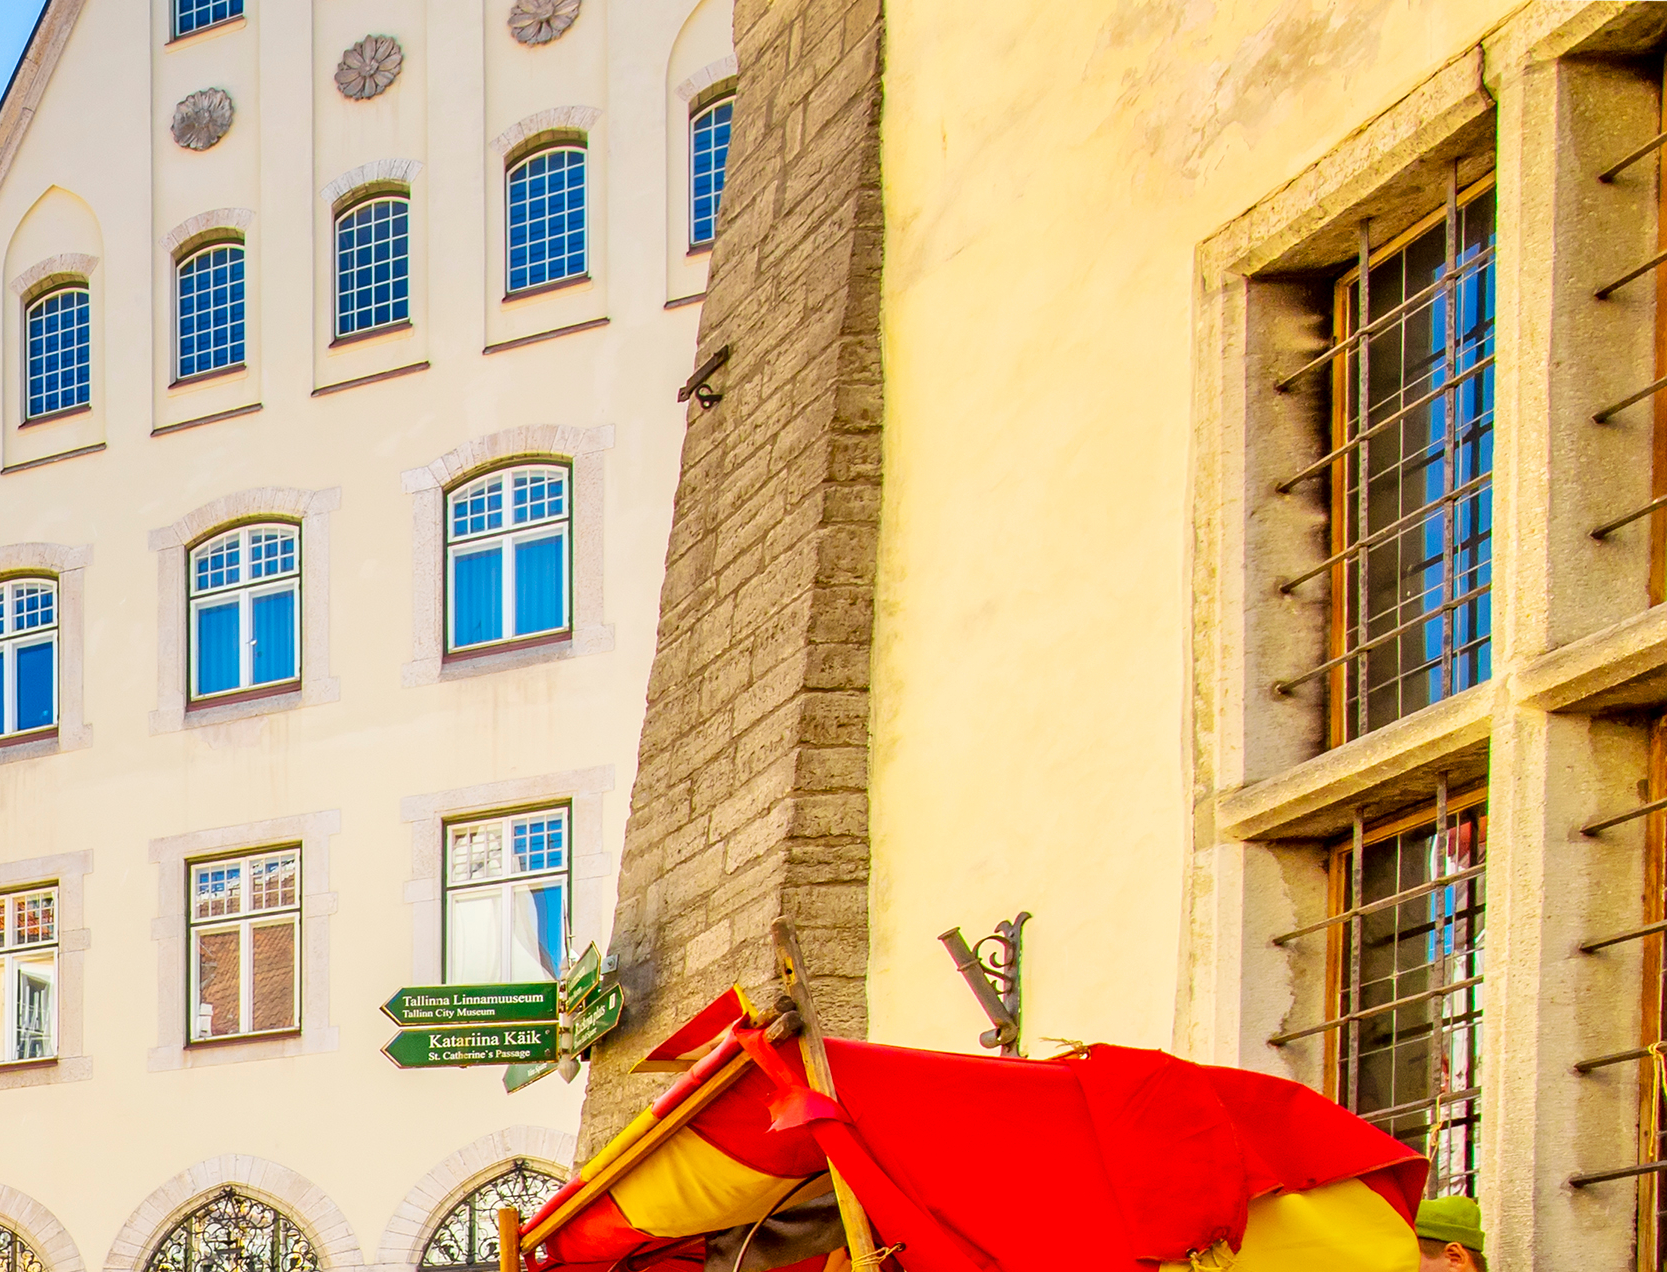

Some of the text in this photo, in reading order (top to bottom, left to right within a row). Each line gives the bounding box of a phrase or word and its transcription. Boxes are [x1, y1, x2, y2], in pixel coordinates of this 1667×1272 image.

[402, 993, 544, 1007] Tallinna Linnamuuseum
[402, 1007, 495, 1019] Tallinn City Museum
[428, 1029, 541, 1049] Katariina Käik
[428, 1052, 441, 1061] St.
[496, 1049, 531, 1059] Passage
